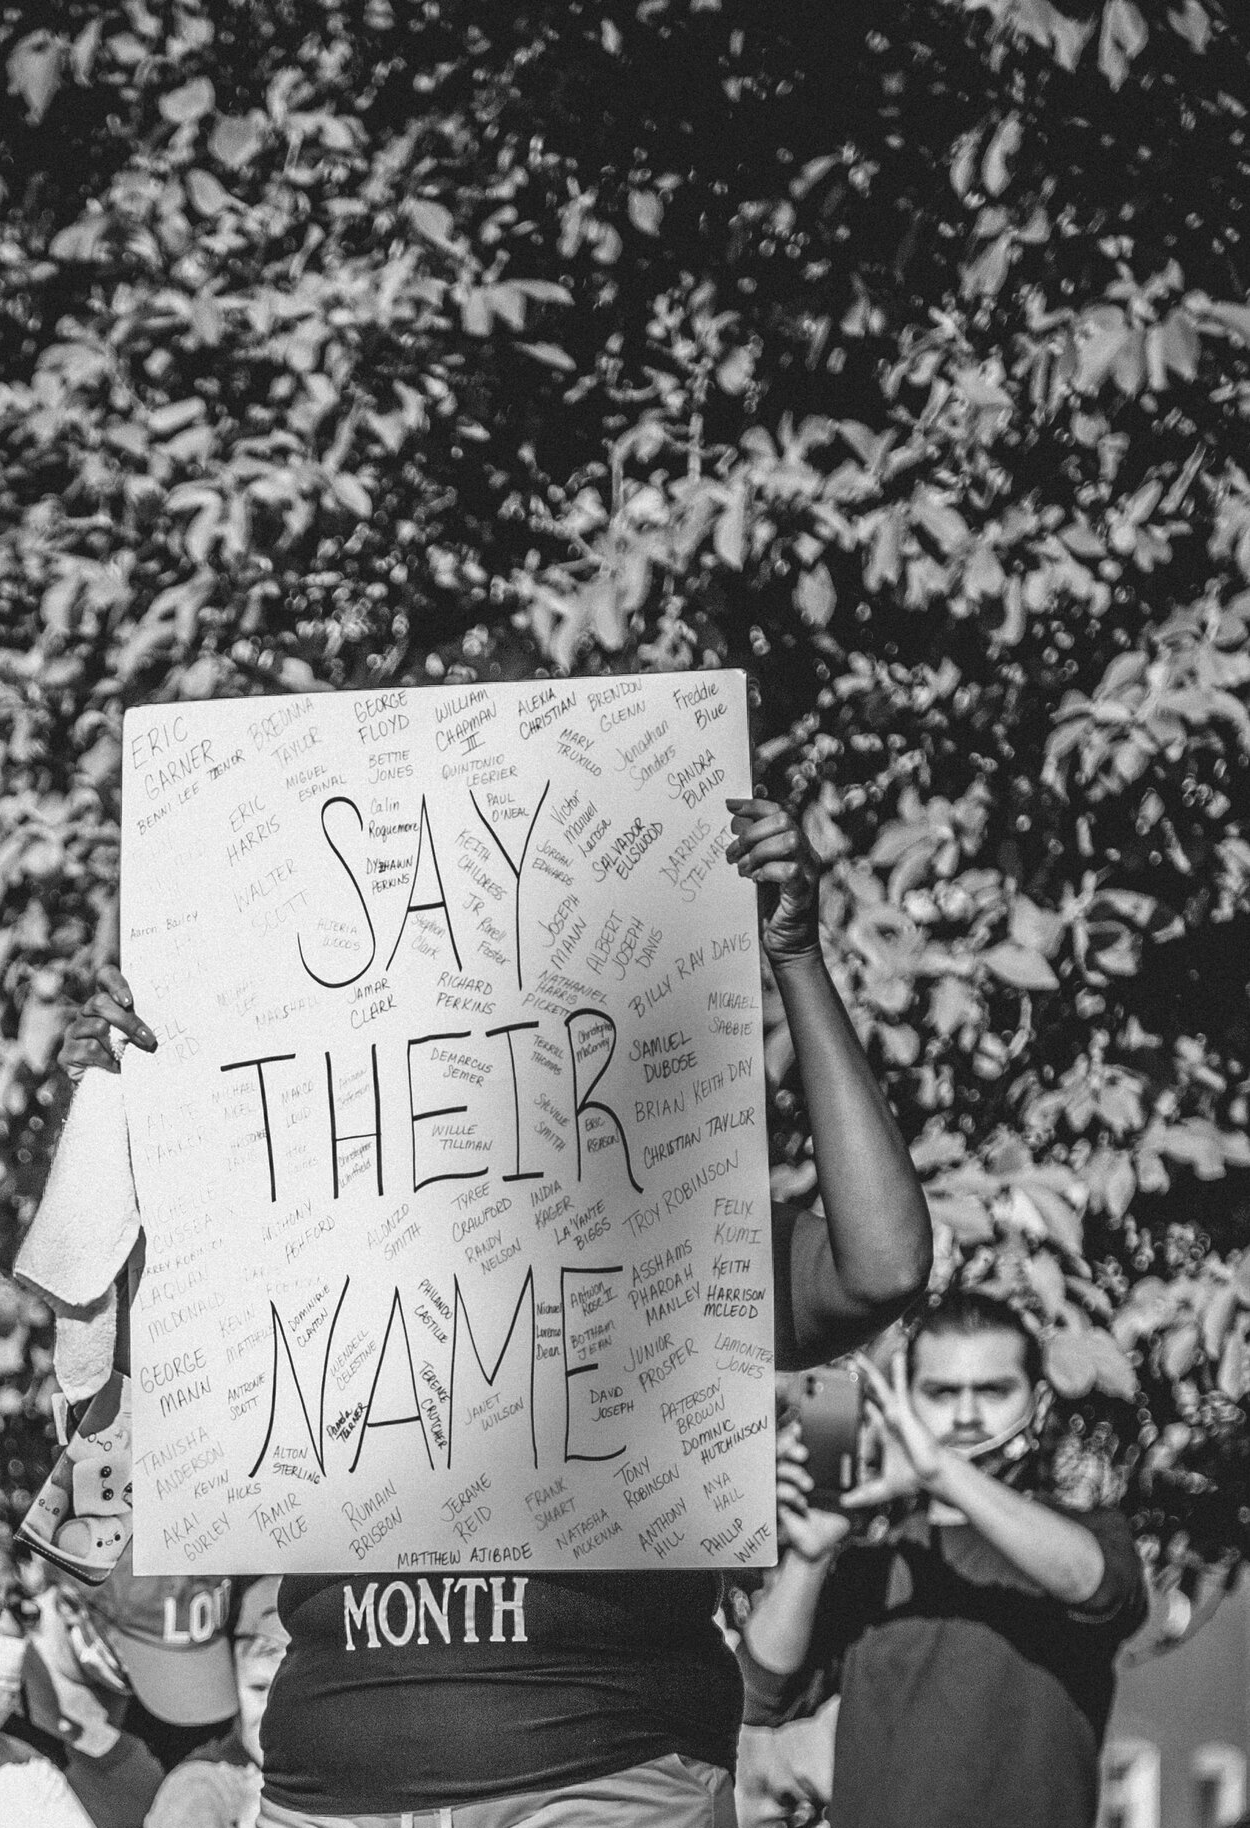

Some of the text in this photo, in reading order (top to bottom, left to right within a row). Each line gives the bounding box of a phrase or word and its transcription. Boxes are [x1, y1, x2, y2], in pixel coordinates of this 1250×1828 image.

[354, 690, 408, 723] GEORGE
[518, 688, 557, 717] ALEXIA
[673, 682, 720, 710] Freddie
[358, 715, 410, 744] FLOYD
[436, 701, 497, 751] CHAPMAN
[519, 691, 578, 740] CHRISTIAN
[600, 700, 645, 732] GLENN
[695, 703, 728, 730] Blue
[131, 716, 188, 770] ERIC
[271, 726, 323, 769] TAYLOR
[459, 731, 486, 756] III
[560, 729, 595, 751] MARY
[614, 720, 669, 772] Jonathan
[144, 739, 214, 800] GARNER
[285, 765, 328, 789] MIGUEL
[368, 765, 414, 784] JONES
[369, 751, 410, 768] BETTIE
[442, 754, 504, 780] QUINTONIO
[466, 766, 518, 788] LEGRIER
[630, 745, 676, 791] Sanders
[667, 749, 716, 799] SANDRA
[178, 781, 199, 805] LEE
[299, 775, 347, 803] ESPINAL
[371, 797, 399, 815] Calin
[487, 793, 515, 807] PAUL
[551, 789, 579, 826] Victor
[682, 769, 725, 810] BLAND
[229, 795, 266, 833] ERIC
[369, 821, 419, 843] Roquemore
[226, 814, 280, 867] HARRIS
[455, 828, 491, 862] KEITH
[537, 839, 574, 868] JORDAN
[592, 817, 645, 883] SALVADOR
[616, 823, 663, 880] ELLSWOOD
[659, 818, 711, 887] DARRIUS
[457, 855, 508, 901] CHILDRESS
[680, 826, 736, 902] STEWART
[234, 859, 298, 912] WALTER
[296, 779, 551, 989] SAY
[372, 874, 410, 895] PERKINS
[462, 892, 485, 916] JR
[538, 894, 579, 948] JOSEPH
[477, 941, 510, 965] Foster
[551, 916, 587, 971] MANN
[586, 909, 623, 975] ALBERT
[612, 916, 645, 981] JOSEPH
[635, 927, 663, 968] DAVIS
[349, 977, 390, 1004] JAMAR
[437, 971, 493, 996] RICHARD
[536, 981, 577, 1004] HARRIS
[539, 970, 609, 1005] NATHANIEL
[628, 932, 751, 1018] BILLY RAY DAVIS
[351, 994, 397, 1029] CLARK
[436, 992, 496, 1015] PERKINS
[707, 992, 759, 1011] MICHAEL
[709, 1016, 753, 1036] SABBIE
[431, 1048, 493, 1074] DEMARCUS
[629, 1030, 692, 1062] SAMUEL
[443, 1065, 485, 1087] SEMER
[643, 1052, 697, 1083] DUBOSE
[221, 1007, 644, 1202] THEIR
[634, 1057, 753, 1123] BRIAN KEITH DAY
[440, 1139, 493, 1151] TILLMAN
[534, 1121, 566, 1153] SMITH
[644, 1107, 756, 1169] CHRISTIAN TAYLOR
[450, 1181, 490, 1210] TYREE
[530, 1180, 562, 1207] INDIA
[535, 1195, 575, 1229] KAGER
[622, 1150, 739, 1238] TROY ROBINSON
[715, 1197, 754, 1216] FELIX
[367, 1203, 410, 1249] ALONZO
[453, 1198, 513, 1242] CRAWFORD
[574, 1217, 611, 1251] BIGGS
[384, 1222, 422, 1261] SMITH
[465, 1230, 502, 1263] RANDY
[481, 1237, 521, 1275] NELSON
[632, 1240, 693, 1288] ASSHAMS
[713, 1253, 751, 1278] KEITH
[417, 1278, 453, 1320] PHILANDO
[628, 1264, 694, 1310] PHAROAH
[646, 1281, 701, 1327] MANLEY
[707, 1285, 766, 1301] HARRISON
[288, 1286, 330, 1332] DOMINIQUE
[297, 1307, 328, 1347] CLAYTON
[704, 1303, 758, 1319] MCLEOD
[330, 1330, 369, 1377] WENDELL
[337, 1340, 377, 1391] CELESTINE
[578, 1336, 612, 1360] JEAN
[623, 1333, 675, 1373] JUNIOR
[639, 1338, 698, 1392] PROSPER
[140, 1347, 207, 1393] GEORGE
[248, 1265, 627, 1478] NAME
[420, 1361, 450, 1404] TERENCE
[716, 1355, 765, 1380] JONES
[160, 1376, 212, 1418] MANN
[230, 1395, 259, 1421] SCOTT
[465, 1393, 501, 1426] JANET
[590, 1386, 623, 1404] DAVID
[591, 1400, 635, 1422] JOSEPH
[660, 1377, 721, 1423] PATERSON
[421, 1399, 448, 1450] CRUTCHER
[482, 1397, 525, 1431] WILSON
[676, 1393, 725, 1435] BROWN
[135, 1426, 209, 1476] TANISHA
[273, 1446, 308, 1460] ALTON
[701, 1415, 768, 1465] HUTCHINSON
[156, 1441, 225, 1500] ANDERSON
[194, 1469, 229, 1499] KEVIN
[273, 1462, 320, 1484] STERLING
[613, 1456, 651, 1486] TONY
[623, 1463, 680, 1509] ROBINSON
[703, 1472, 731, 1499] MYA
[227, 1483, 262, 1504] HICKS
[248, 1492, 301, 1532] TAMIR
[341, 1478, 397, 1532] RUMAIN
[440, 1472, 492, 1522] JERAME
[525, 1477, 568, 1512] FRANK
[713, 1488, 745, 1512] HALL
[163, 1512, 199, 1549] AKAI
[270, 1516, 308, 1549] RICE
[453, 1506, 492, 1544] REID
[535, 1497, 577, 1531] SMART
[556, 1508, 609, 1550] NATASHA
[638, 1497, 687, 1552] ANTHONY
[184, 1511, 231, 1562] GURLEY
[350, 1506, 403, 1561] BRISBON
[572, 1521, 623, 1560] MCKENNA
[653, 1531, 685, 1560] HILL
[700, 1517, 744, 1556] PHILLIP
[734, 1522, 771, 1564] WHITE
[398, 1542, 533, 1569] MATTHEW AJIBADE
[344, 1576, 528, 1651] MONTH
